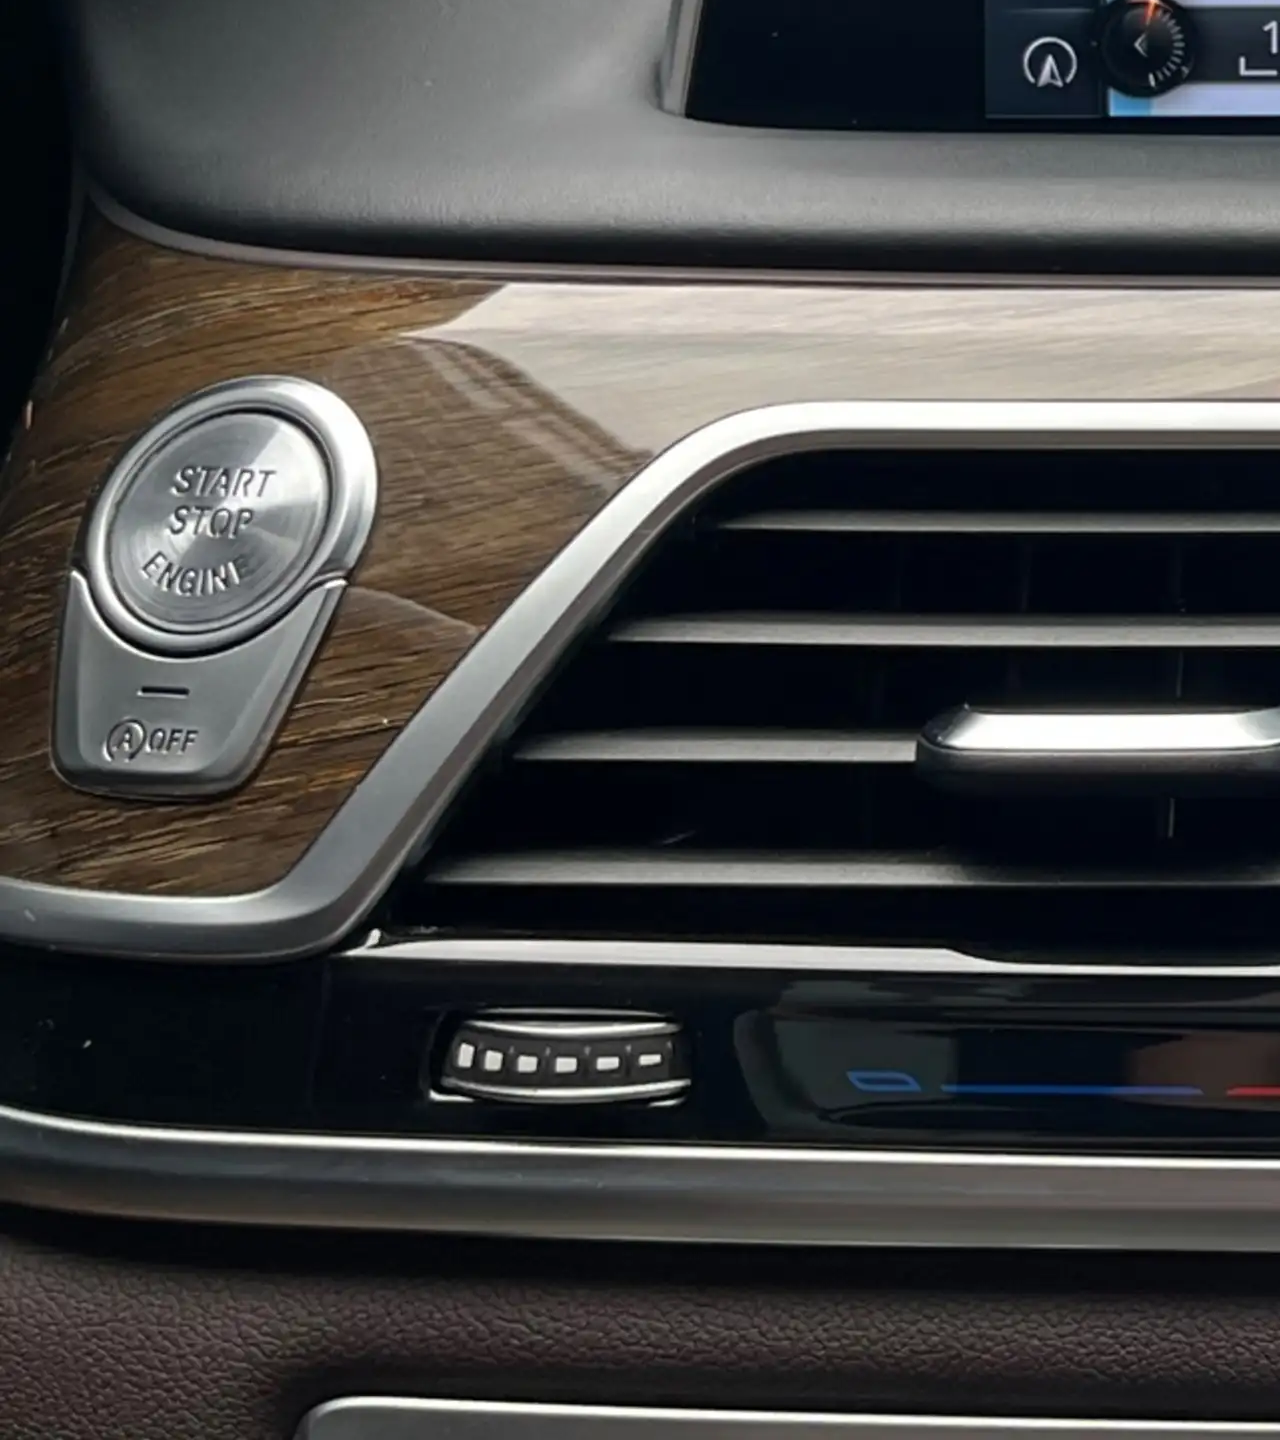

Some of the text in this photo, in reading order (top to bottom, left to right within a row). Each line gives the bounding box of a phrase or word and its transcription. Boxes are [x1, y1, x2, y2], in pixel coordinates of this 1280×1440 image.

[170, 464, 278, 498] START
[164, 504, 254, 539] STOP
[139, 550, 249, 597] ENGINE
[145, 727, 200, 755] OFF
